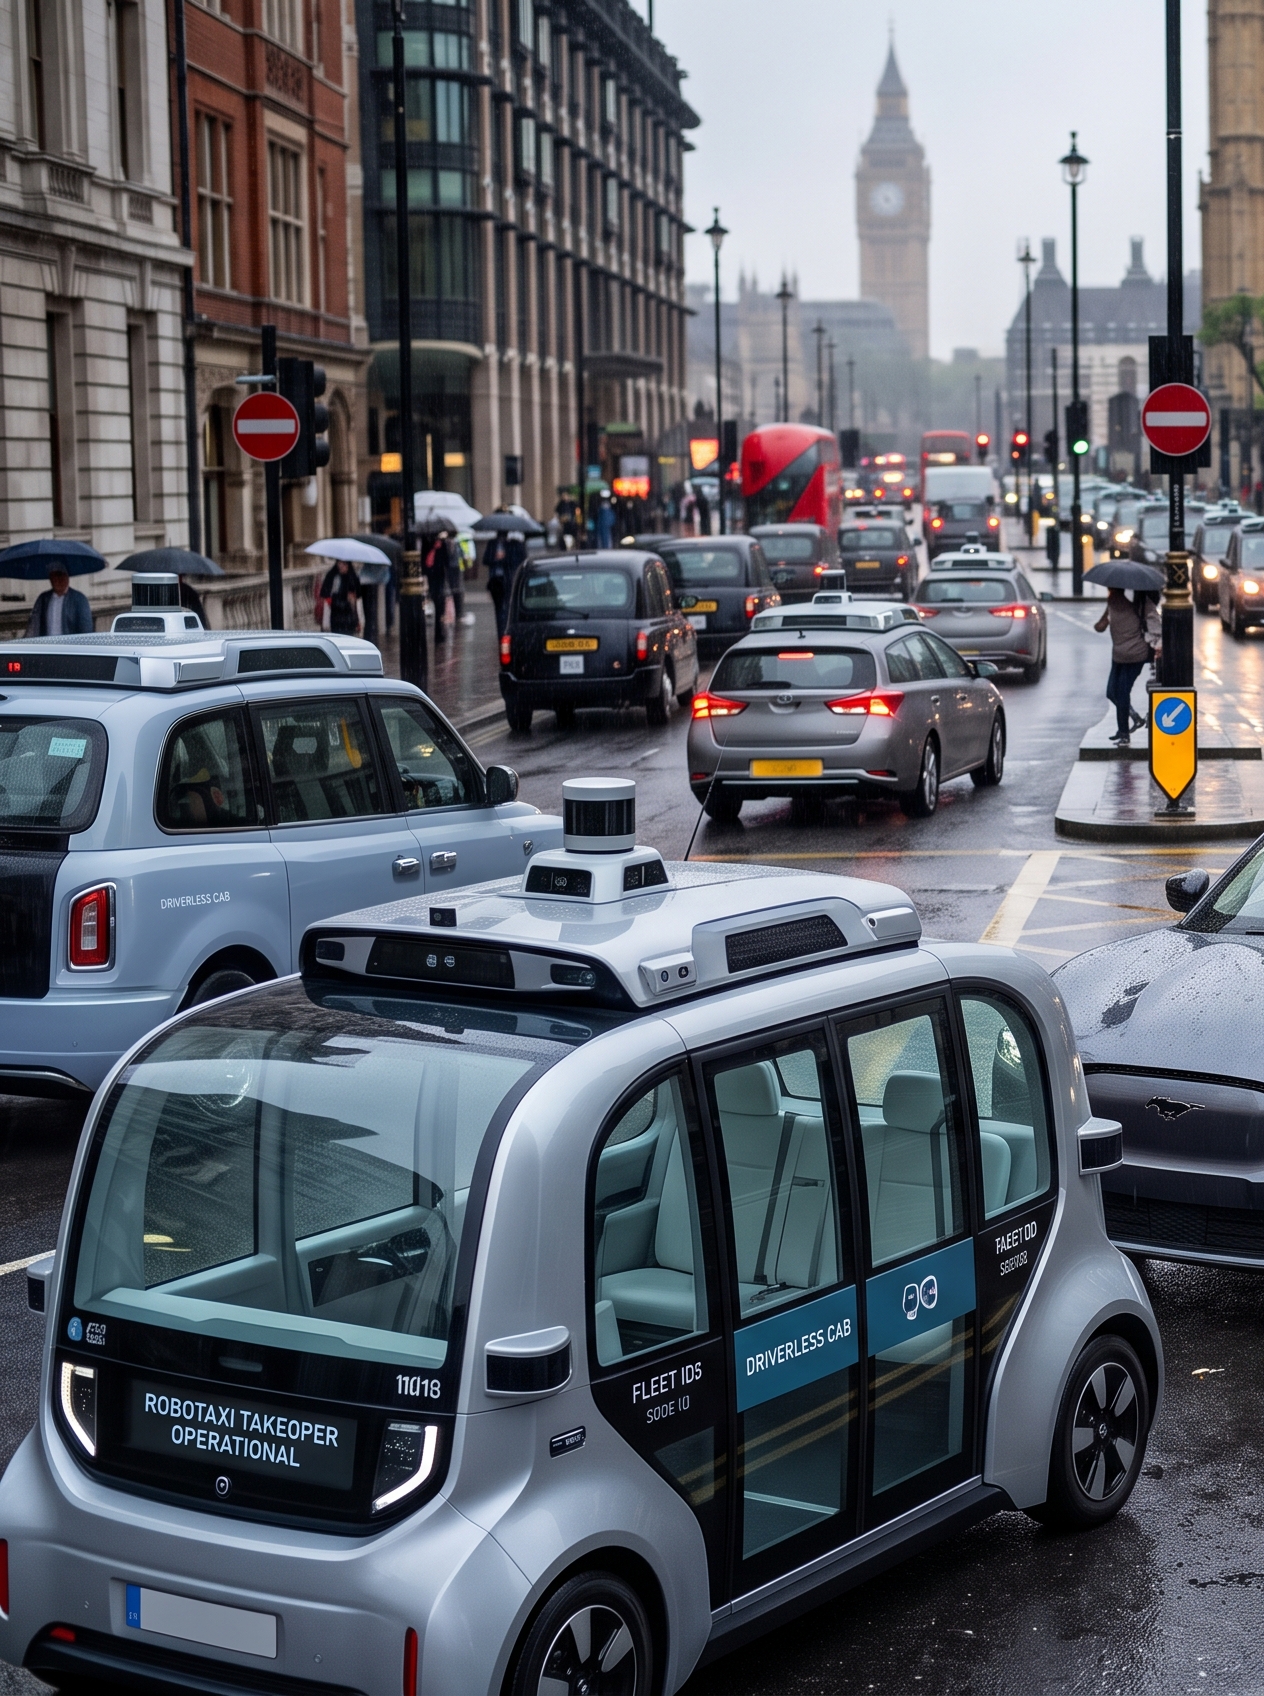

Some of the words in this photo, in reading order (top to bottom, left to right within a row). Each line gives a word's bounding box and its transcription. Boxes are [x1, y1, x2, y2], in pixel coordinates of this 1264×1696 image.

[160, 893, 212, 910] DRIVERLESS
[212, 891, 231, 903] CAB
[746, 1329, 825, 1377] DRIVERLESS
[827, 1318, 852, 1343] CAB
[632, 1369, 678, 1405] FLEET
[681, 1361, 702, 1386] IDS
[145, 1392, 235, 1428] ROBOTAXI
[239, 1410, 339, 1448] TAKEOPER
[171, 1424, 300, 1468] OPERATIONAL
